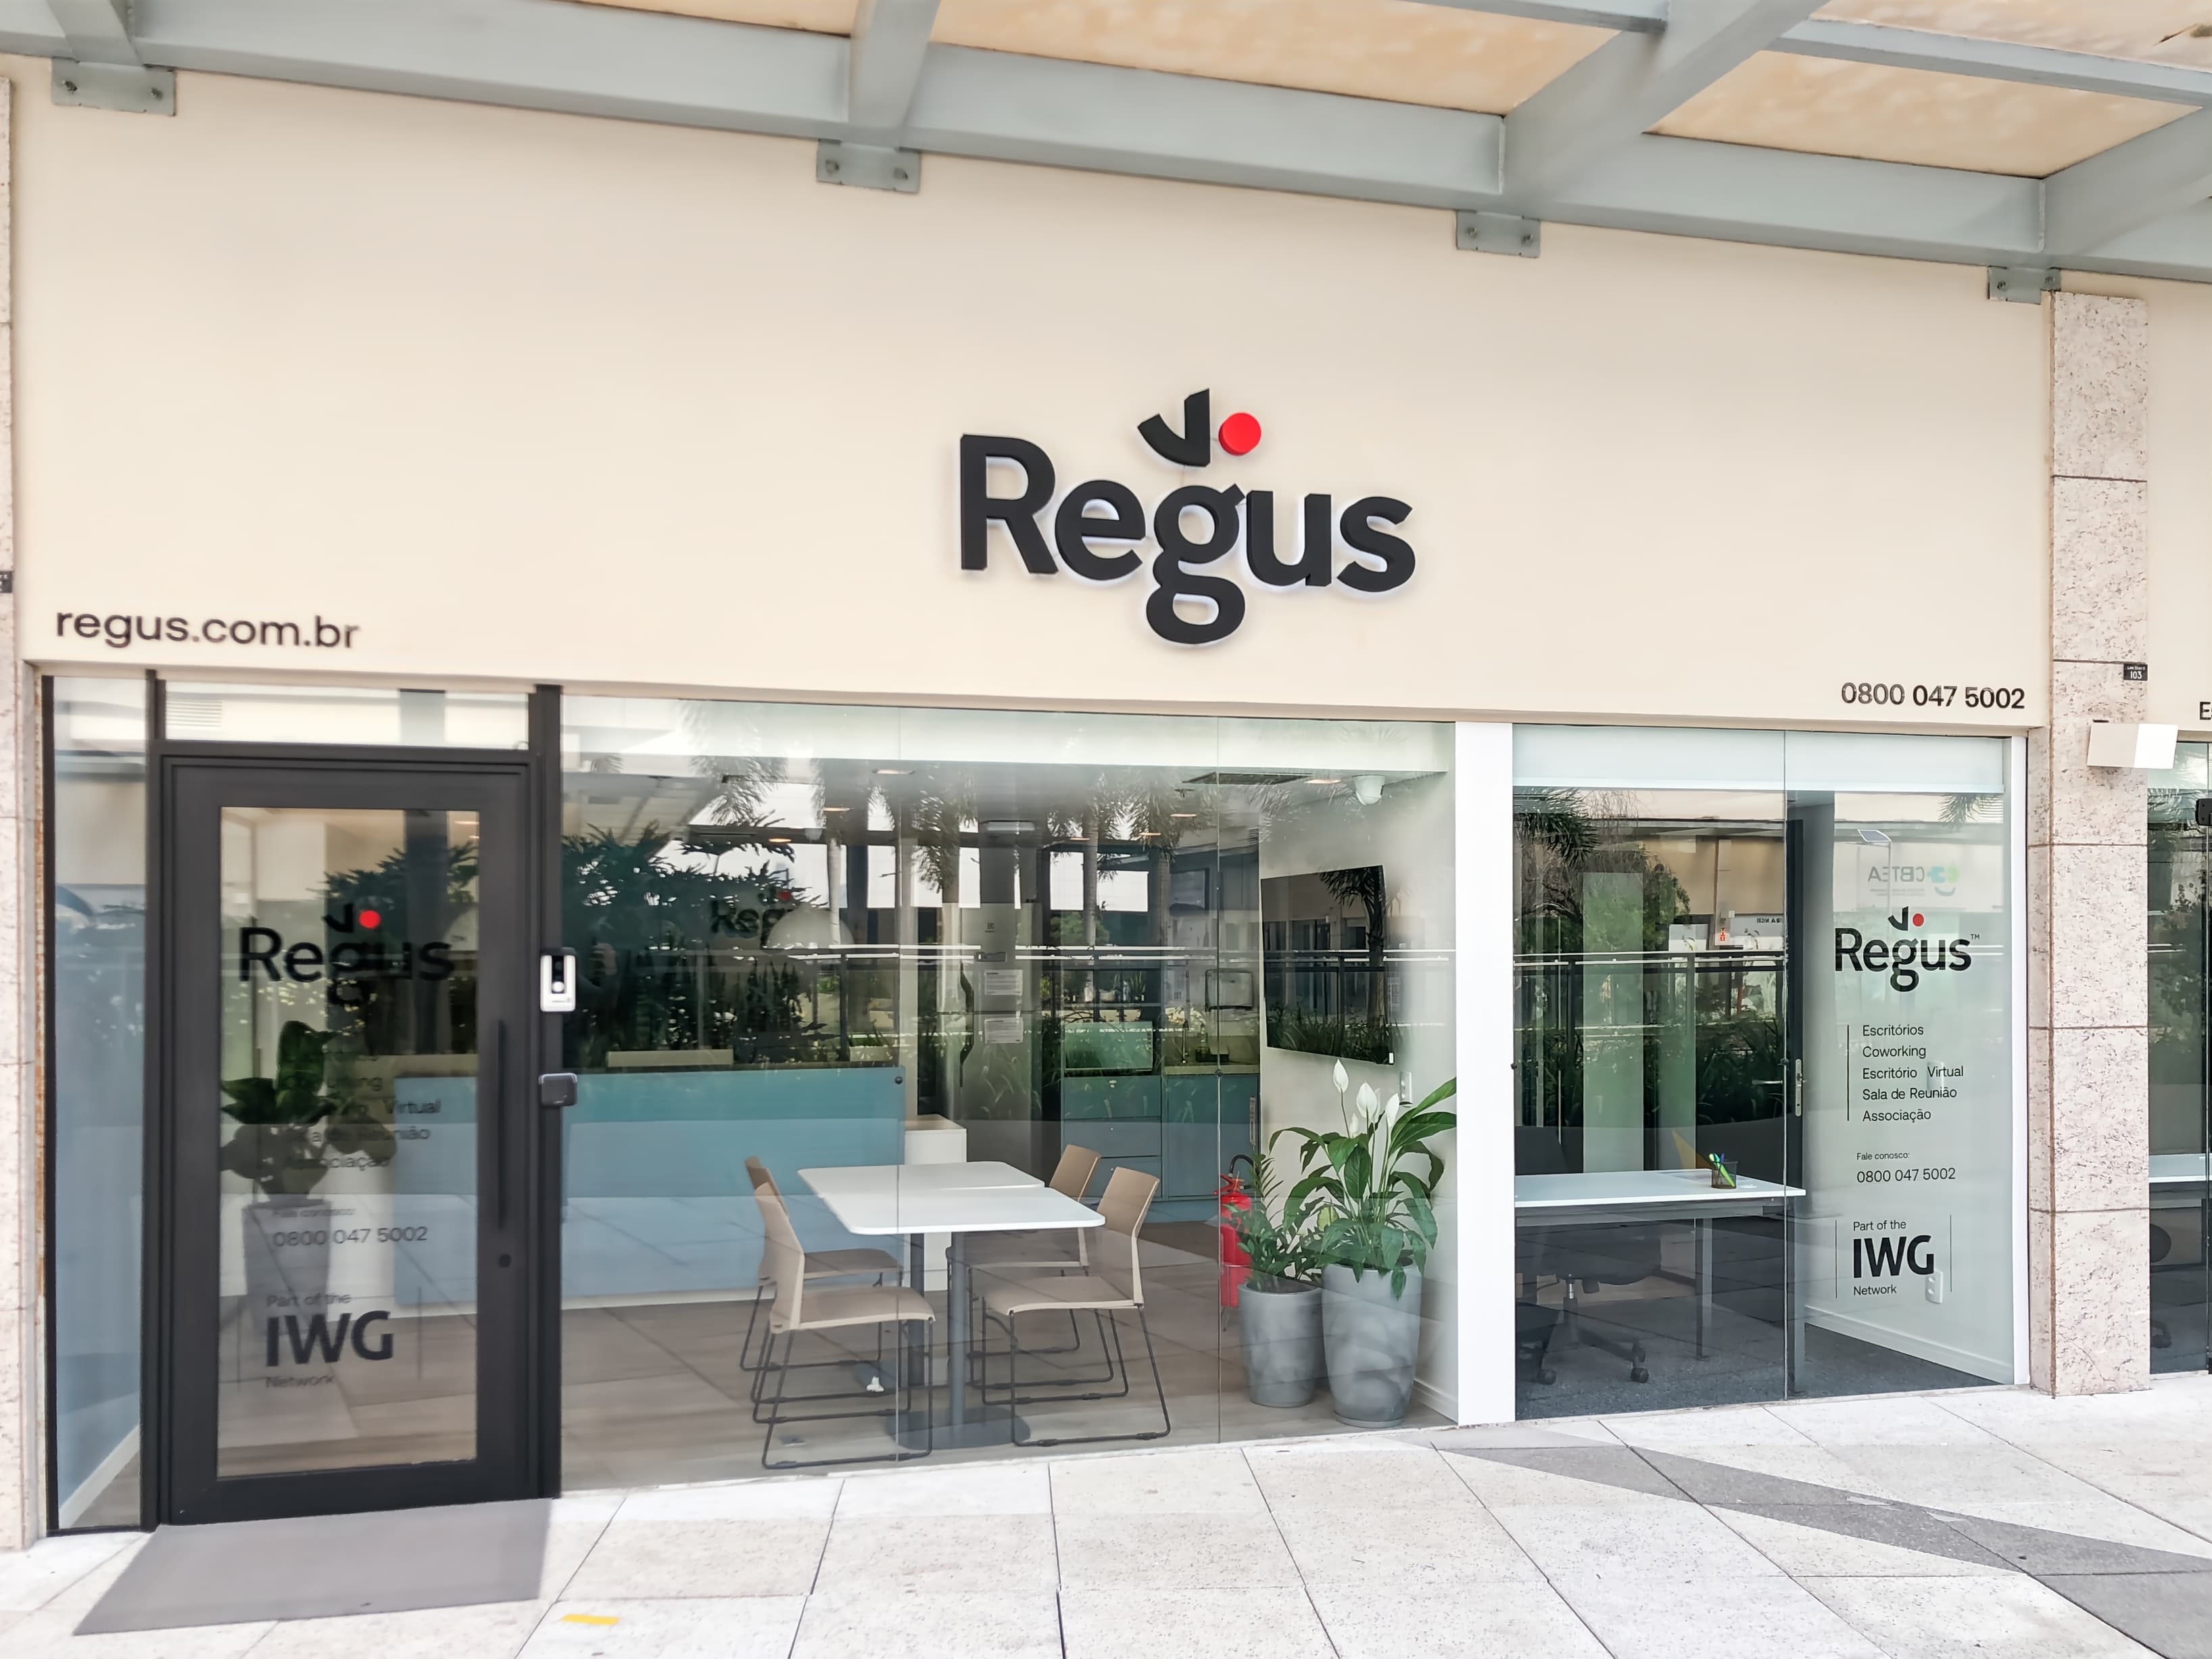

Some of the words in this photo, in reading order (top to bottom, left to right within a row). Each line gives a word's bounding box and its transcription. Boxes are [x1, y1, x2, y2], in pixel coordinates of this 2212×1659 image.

[961, 433, 1416, 645] Regus
[56, 611, 360, 648] regus.com.br
[2130, 671, 2142, 679] 103
[1841, 682, 1906, 706] 0800
[1913, 684, 1958, 707] 047
[1965, 686, 2025, 709] 5002
[2200, 700, 2212, 721] E
[239, 926, 455, 1006] Regus
[1834, 927, 1972, 992] Regus
[1862, 1024, 1925, 1036] Escritórios
[1862, 1045, 1927, 1059] Coworking
[1862, 1067, 1918, 1080] Escritório
[1927, 1065, 1965, 1078] Virtual
[1862, 1088, 1888, 1101] Sala
[1891, 1088, 1906, 1100] de
[1910, 1086, 1958, 1099] Reunião
[1862, 1109, 1932, 1123] Associação
[1856, 1152, 1873, 1161] Fale
[1875, 1152, 1910, 1160] conosco:
[1857, 1170, 1892, 1183] 0800
[1895, 1169, 1919, 1182] 047
[1923, 1167, 1956, 1180] 5002
[1853, 1221, 1874, 1232] Part
[1877, 1220, 1888, 1230] of
[1890, 1220, 1907, 1230] the
[274, 1230, 327, 1247] 0800
[333, 1228, 372, 1244] 047
[377, 1226, 429, 1243] 5002
[1853, 1234, 1935, 1279] IWG
[1854, 1284, 1898, 1296] Network
[265, 1309, 395, 1368] IWG
